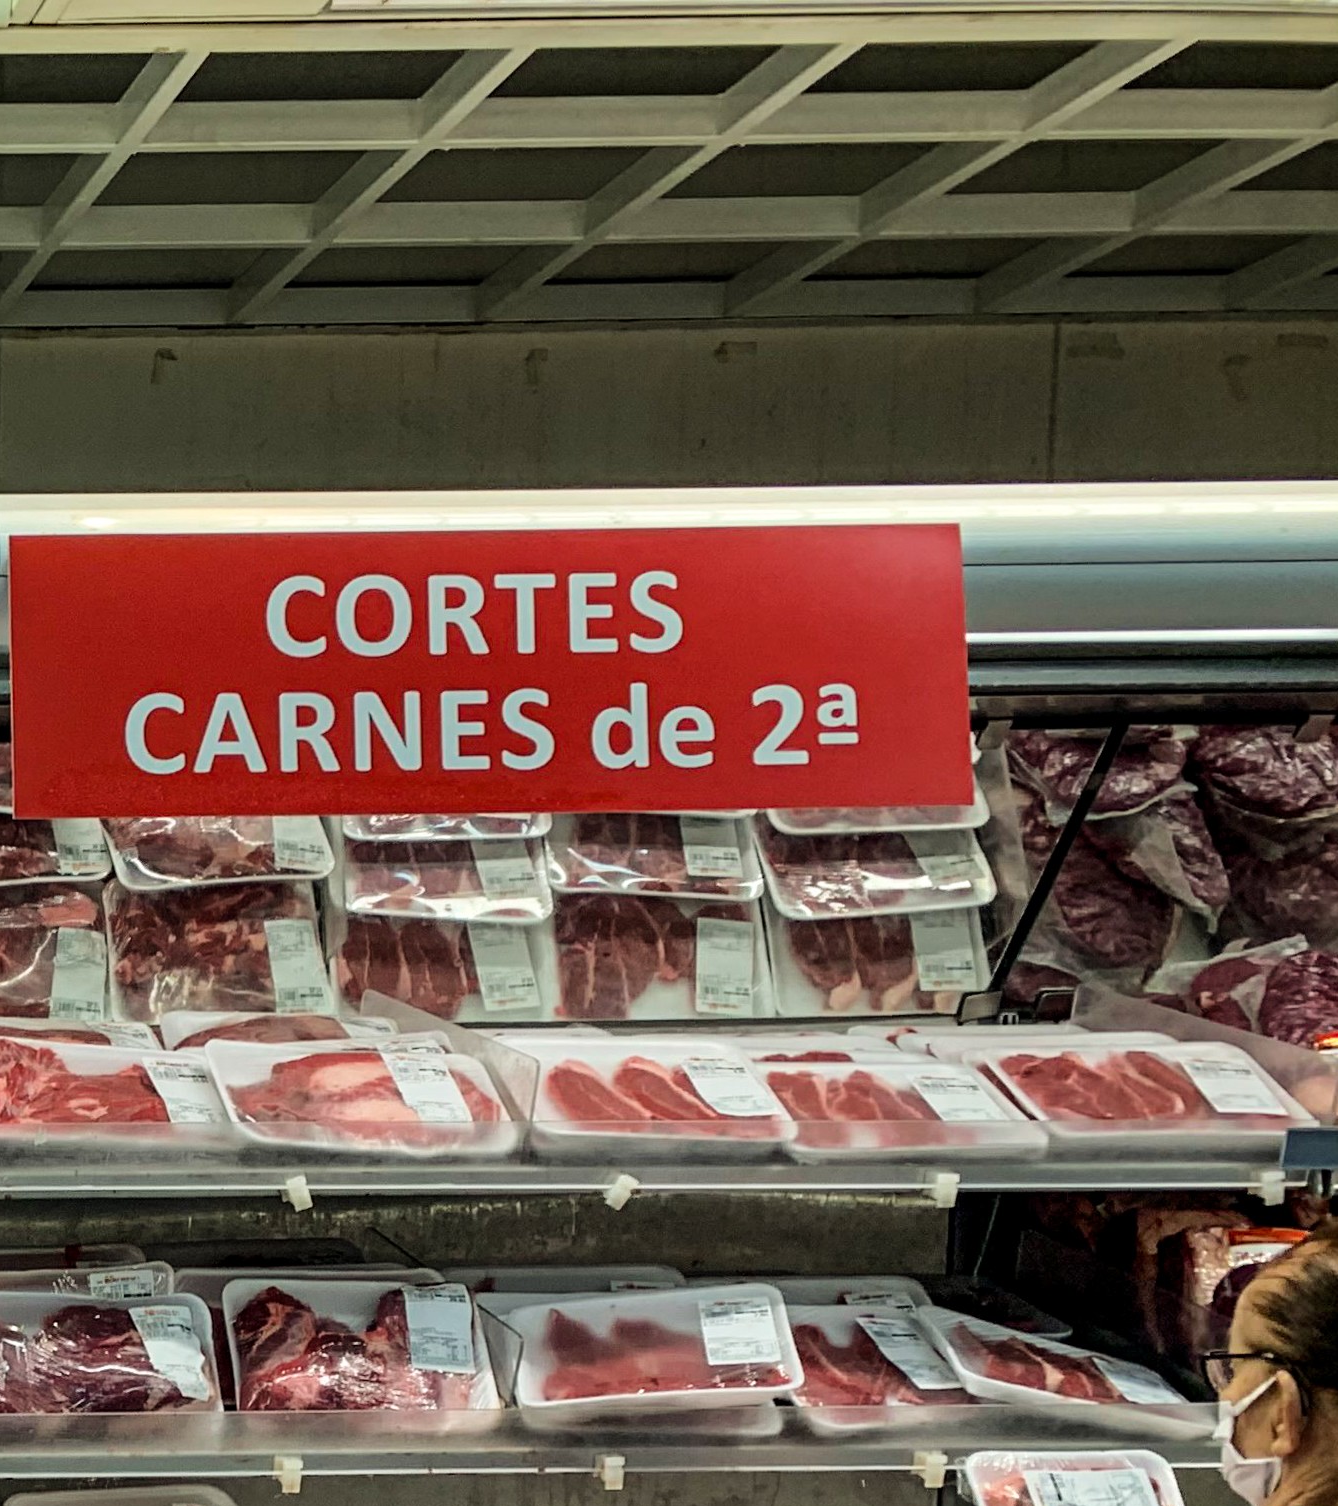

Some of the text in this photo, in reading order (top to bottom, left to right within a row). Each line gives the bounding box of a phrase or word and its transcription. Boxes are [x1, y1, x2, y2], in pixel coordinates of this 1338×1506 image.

[266, 570, 684, 658] CORTES
[124, 682, 860, 775] CARNES de 2ª
